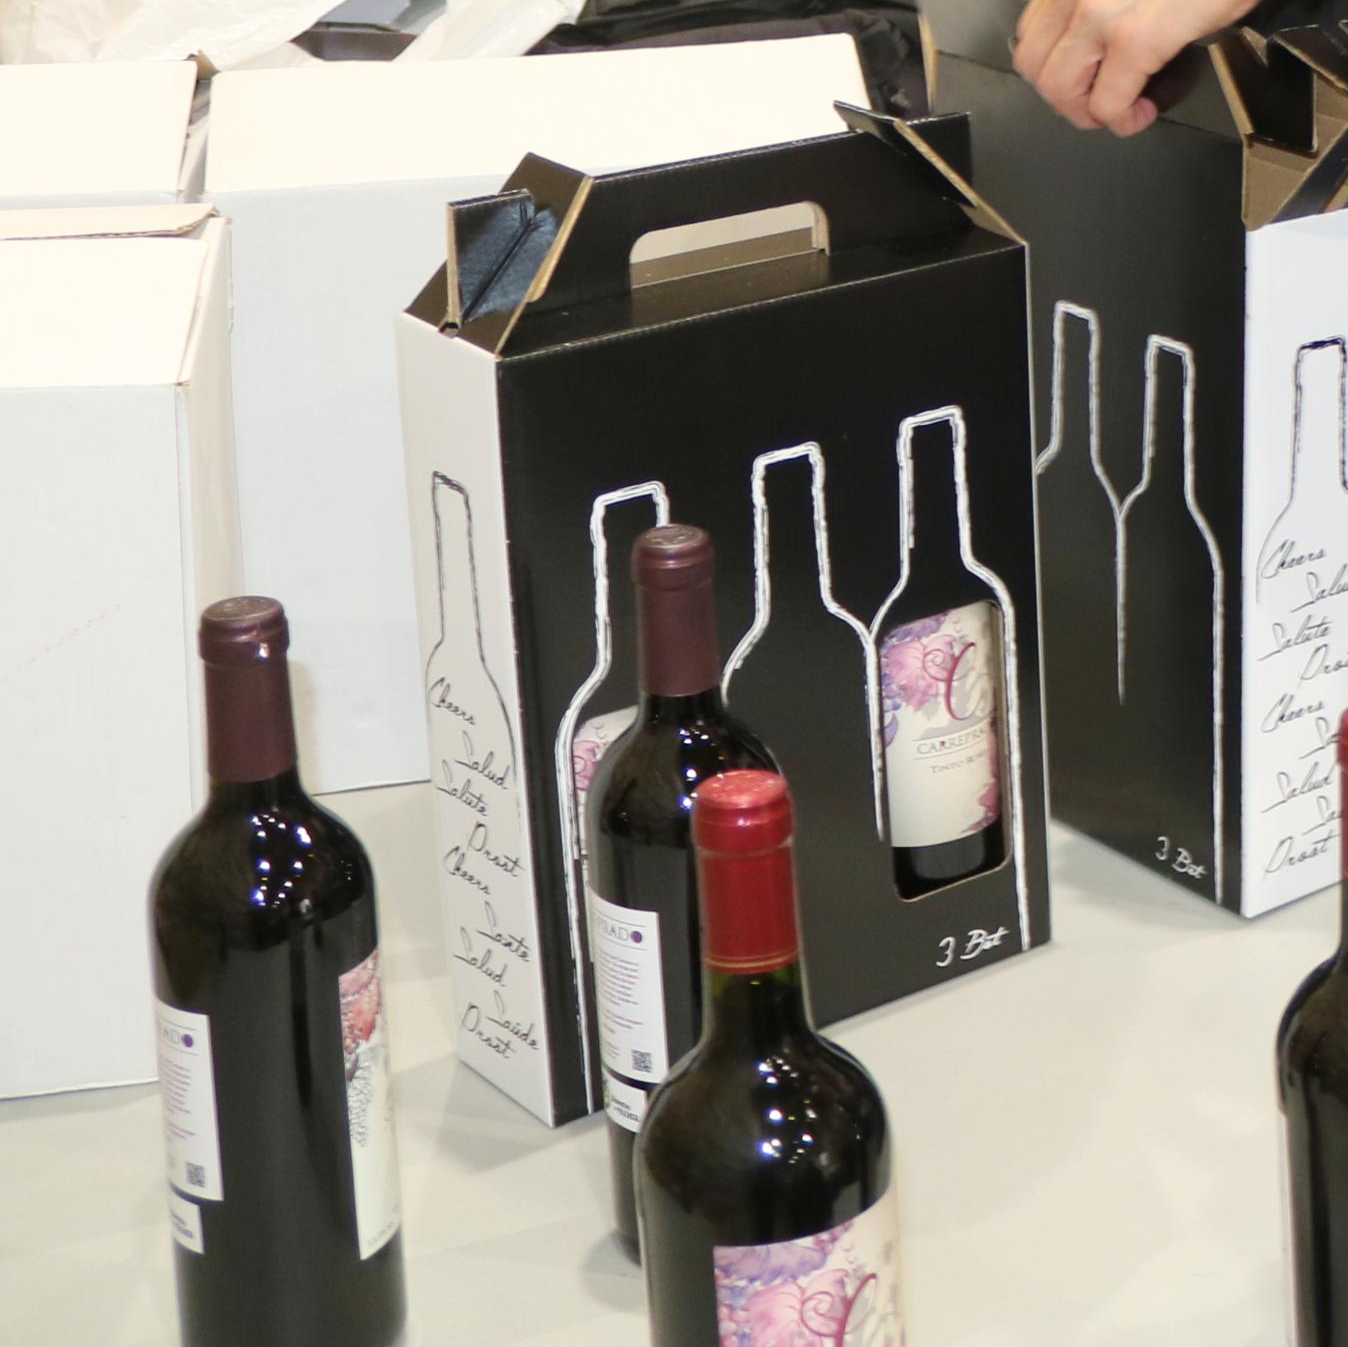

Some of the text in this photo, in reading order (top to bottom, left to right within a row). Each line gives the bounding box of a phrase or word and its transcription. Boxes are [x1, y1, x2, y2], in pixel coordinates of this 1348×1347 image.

[1260, 538, 1327, 580] Cheers
[1255, 614, 1334, 662] Salute
[427, 676, 477, 726] Cheers
[1260, 692, 1326, 733] Cheers
[454, 729, 509, 790] Salud
[434, 758, 488, 817] Salute
[1260, 761, 1338, 814] Salud
[442, 845, 492, 896] Cheers
[1154, 835, 1171, 861] 3
[452, 925, 508, 988] Salud
[935, 935, 956, 967] 3
